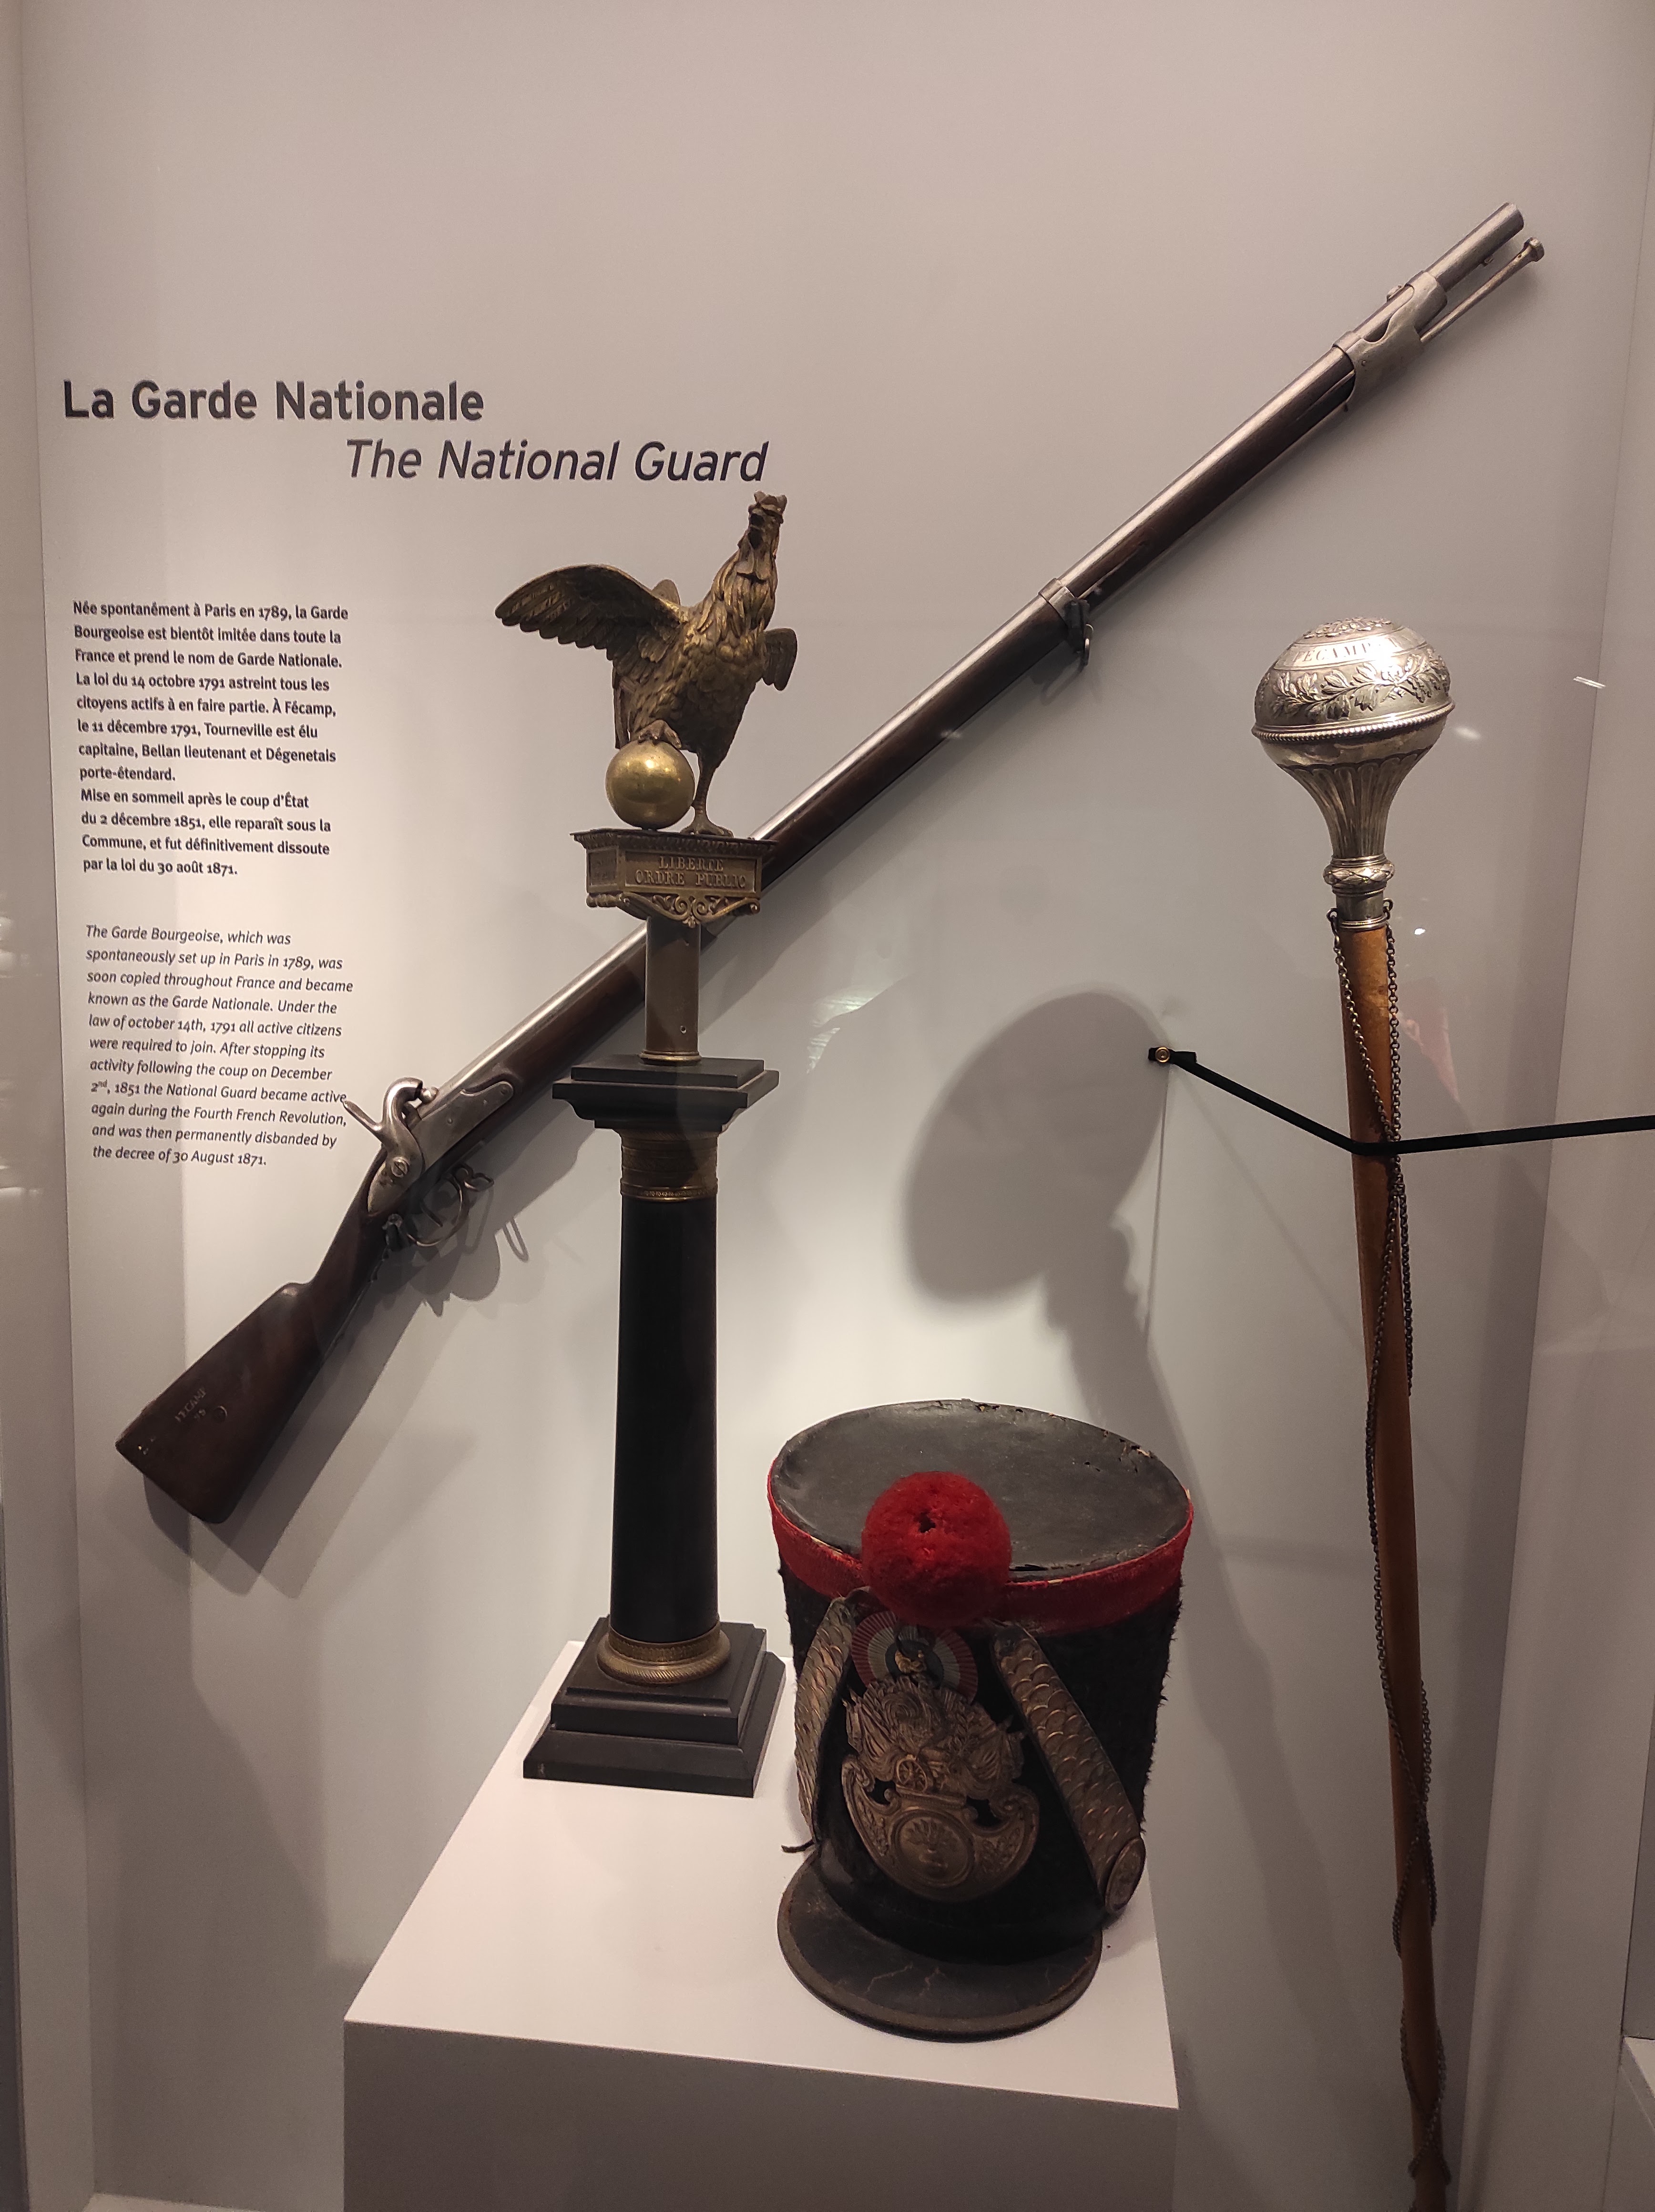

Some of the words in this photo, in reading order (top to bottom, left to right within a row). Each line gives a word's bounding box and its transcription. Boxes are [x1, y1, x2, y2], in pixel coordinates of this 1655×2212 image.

[63, 379, 115, 420] La
[132, 379, 257, 420] Garde
[276, 379, 484, 422] Nationale
[347, 438, 422, 480] The
[438, 439, 620, 481] National
[634, 440, 770, 482] Guard
[72, 600, 98, 615] Née
[100, 601, 191, 619] spontanément
[193, 602, 201, 617] à
[204, 603, 236, 618] Paris
[239, 607, 255, 618] en
[258, 604, 292, 622] 1789,
[295, 604, 307, 620] la
[310, 605, 348, 621] Garde
[74, 624, 145, 642] Bourgeoise
[147, 627, 168, 641] est
[170, 625, 215, 642] bientôt
[217, 626, 257, 642] imitée
[259, 628, 291, 643] dans
[293, 630, 327, 644] toute
[329, 629, 341, 645] la
[74, 647, 115, 663] France
[118, 650, 131, 664] et
[133, 649, 170, 666] prend
[173, 650, 185, 665] le
[188, 654, 215, 665] nom
[218, 650, 235, 666] de
[237, 652, 275, 667] Garde
[278, 652, 342, 668] Nationale.
[76, 671, 91, 686] La
[93, 671, 109, 686] loi
[112, 672, 128, 687] du
[130, 676, 146, 690] 14
[148, 674, 196, 688] octobre
[198, 677, 225, 692] 1791
[228, 675, 277, 691] astreint
[279, 677, 308, 691] tous
[310, 676, 330, 692] les
[76, 694, 128, 713] citoyens
[131, 696, 165, 711] actifs
[167, 696, 176, 711] à
[178, 700, 194, 712] en
[197, 697, 226, 713] faire
[229, 699, 269, 716] partie.
[272, 697, 282, 714] À
[285, 700, 337, 719] Fécamp,
[77, 718, 90, 733] le
[92, 721, 104, 733] 11
[107, 718, 168, 735] décembre
[170, 724, 201, 738] 1791,
[204, 722, 273, 737] Tourneville
[276, 725, 296, 738] est
[298, 724, 318, 739] élu
[78, 742, 139, 759] capitaine,
[142, 743, 181, 758] Bellan
[184, 744, 247, 760] lieutenant
[249, 748, 263, 761] et
[266, 747, 337, 764] Dégenetais
[79, 765, 176, 782] porte-étendard.
[81, 788, 111, 802] Mise
[113, 792, 129, 803] en
[132, 790, 185, 805] sommeil
[187, 791, 223, 809] après
[225, 792, 237, 807] le
[240, 796, 270, 810] coup
[81, 810, 97, 825] du
[100, 814, 108, 825] 2
[111, 811, 172, 828] décembre
[174, 814, 205, 831] 1851,
[208, 815, 232, 829] elle
[235, 816, 284, 833] reparaît
[286, 820, 317, 832] sous
[319, 818, 331, 832] la
[82, 833, 147, 852] Commune,
[149, 837, 162, 850] et
[164, 836, 183, 850] fut
[185, 837, 275, 854] définitivement
[276, 840, 330, 856] dissoute
[83, 859, 104, 873] par
[106, 857, 118, 871] la
[120, 857, 136, 872] loi
[139, 858, 155, 872] du
[157, 862, 174, 876] 30
[176, 860, 204, 874] août
[206, 861, 238, 878] 1871.
[658, 855, 724, 872] LIBERTE
[634, 869, 685, 886] ORDRE
[695, 872, 747, 889] PUBLIC
[86, 924, 108, 939] The
[111, 925, 148, 940] Garde
[151, 927, 224, 944] Bourgeoise,
[227, 930, 263, 944] which
[266, 934, 291, 945] was
[85, 949, 176, 966] spontaneously
[177, 952, 198, 964] set
[200, 954, 216, 968] up
[219, 952, 231, 965] in
[234, 952, 265, 967] Paris
[267, 953, 279, 967] in
[282, 955, 314, 972] 1789,
[318, 959, 343, 970] was
[86, 972, 117, 983] soon
[120, 971, 162, 987] copied
[163, 972, 233, 990] throughout
[235, 975, 276, 990] France
[278, 977, 303, 991] and
[305, 977, 354, 993] became
[87, 991, 129, 1006] known
[131, 996, 146, 1007] as
[149, 993, 169, 1008] the
[172, 995, 208, 1009] Garde
[211, 996, 273, 1012] Nationale.
[277, 999, 316, 1014] Under
[317, 1000, 337, 1014] the
[88, 1013, 111, 1027] law
[112, 1014, 127, 1031] of
[128, 1015, 176, 1030] october
[177, 1018, 206, 1034] 14th,
[210, 1022, 235, 1035] 1791
[239, 1020, 255, 1034] all
[257, 1021, 293, 1035] active
[296, 1022, 342, 1037] citizens
[89, 1039, 119, 1050] were
[121, 1038, 173, 1054] required
[175, 1040, 188, 1053] to
[189, 1040, 216, 1056] join.
[219, 1041, 251, 1057] After
[252, 1044, 307, 1061] stopping
[310, 1045, 325, 1058] its
[90, 1058, 135, 1075] activity
[136, 1059, 193, 1078] following
[196, 1062, 215, 1076] the
[218, 1066, 248, 1080] coup
[251, 1067, 267, 1078] on
[270, 1065, 333, 1081] December
[114, 1081, 141, 1097] 1851
[143, 1082, 163, 1096] the
[166, 1083, 218, 1098] National
[220, 1086, 258, 1100] Guard
[260, 1086, 308, 1102] became
[311, 1090, 347, 1103] active
[91, 1102, 125, 1118] again
[128, 1103, 168, 1120] during
[171, 1105, 190, 1118] the
[194, 1106, 233, 1121] Fourth
[236, 1108, 276, 1122] French
[279, 1109, 347, 1127] Revolution,
[92, 1123, 116, 1137] and
[118, 1127, 143, 1139] was
[145, 1125, 173, 1139] then
[174, 1130, 253, 1146] permanently
[255, 1130, 319, 1146] disbanded
[322, 1133, 337, 1150] by
[92, 1145, 112, 1158] the
[114, 1146, 155, 1160] decree
[158, 1147, 173, 1164] of
[172, 1151, 189, 1164] 30
[190, 1150, 235, 1166] August
[237, 1152, 266, 1167] 1871.
